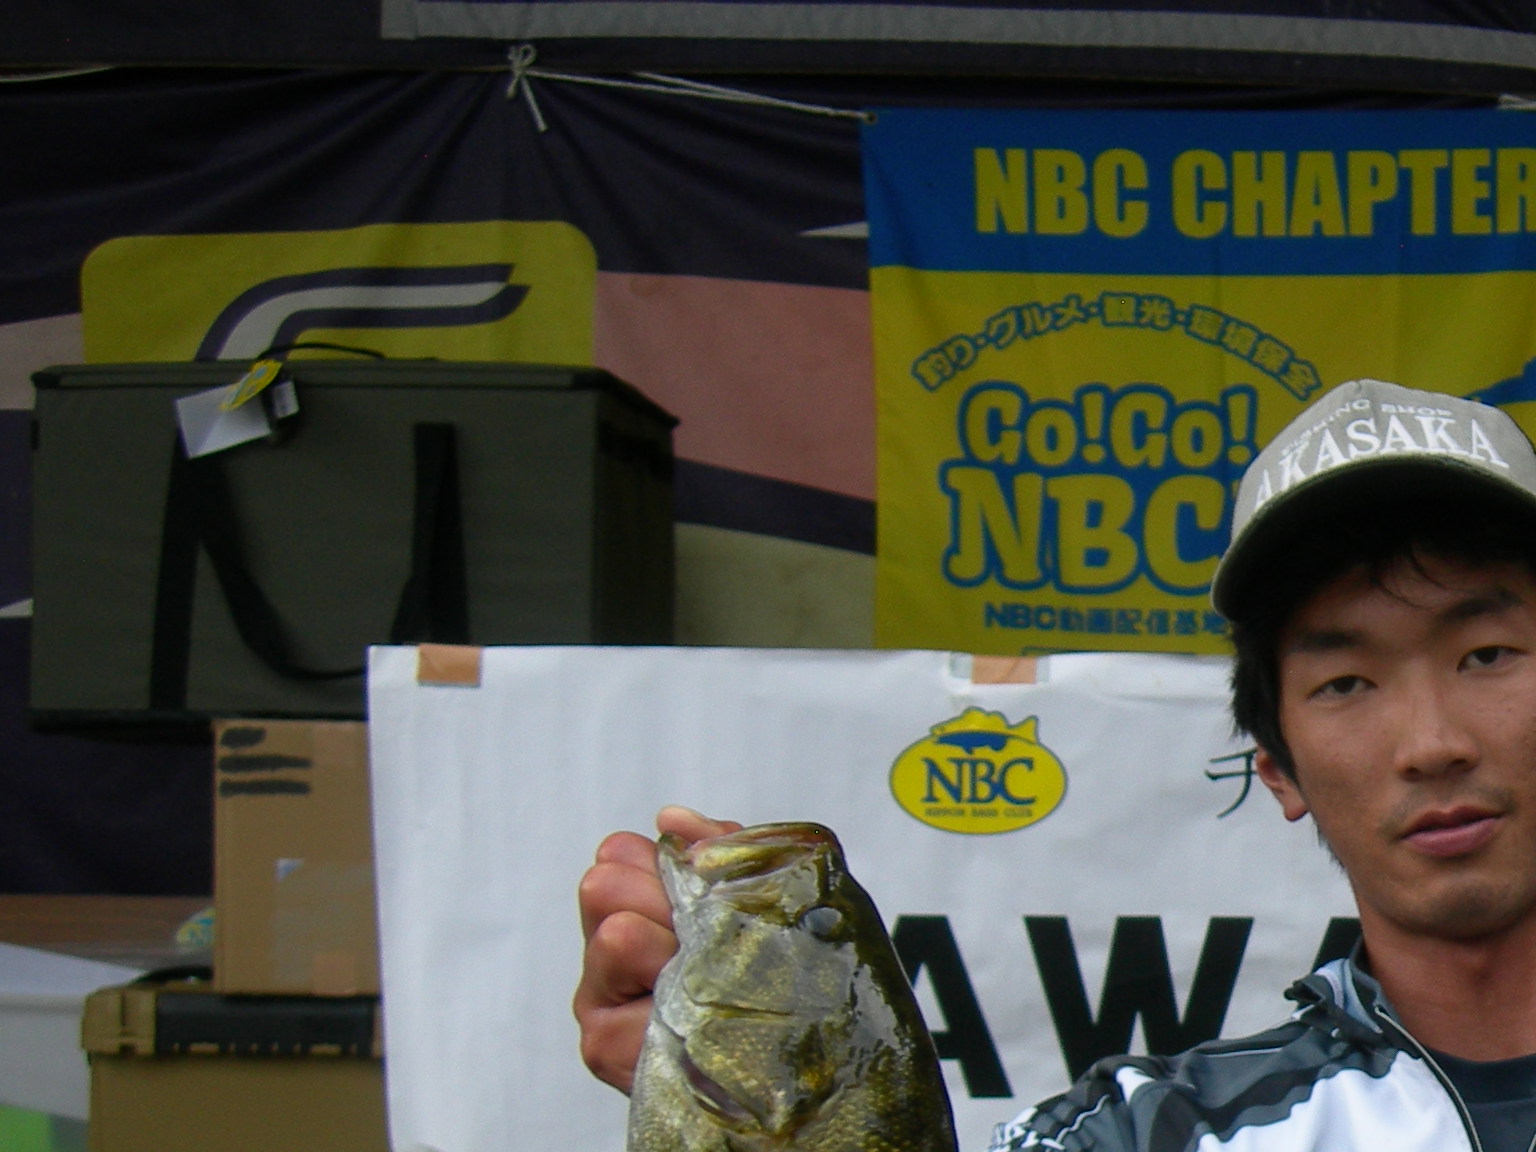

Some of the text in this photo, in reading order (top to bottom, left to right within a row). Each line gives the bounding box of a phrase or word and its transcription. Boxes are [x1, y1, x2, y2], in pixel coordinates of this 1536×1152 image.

[973, 147, 1149, 238] NBC
[1255, 413, 1511, 510] AKASAKA
[940, 461, 1239, 596] NBC
[920, 756, 1037, 806] NBC
